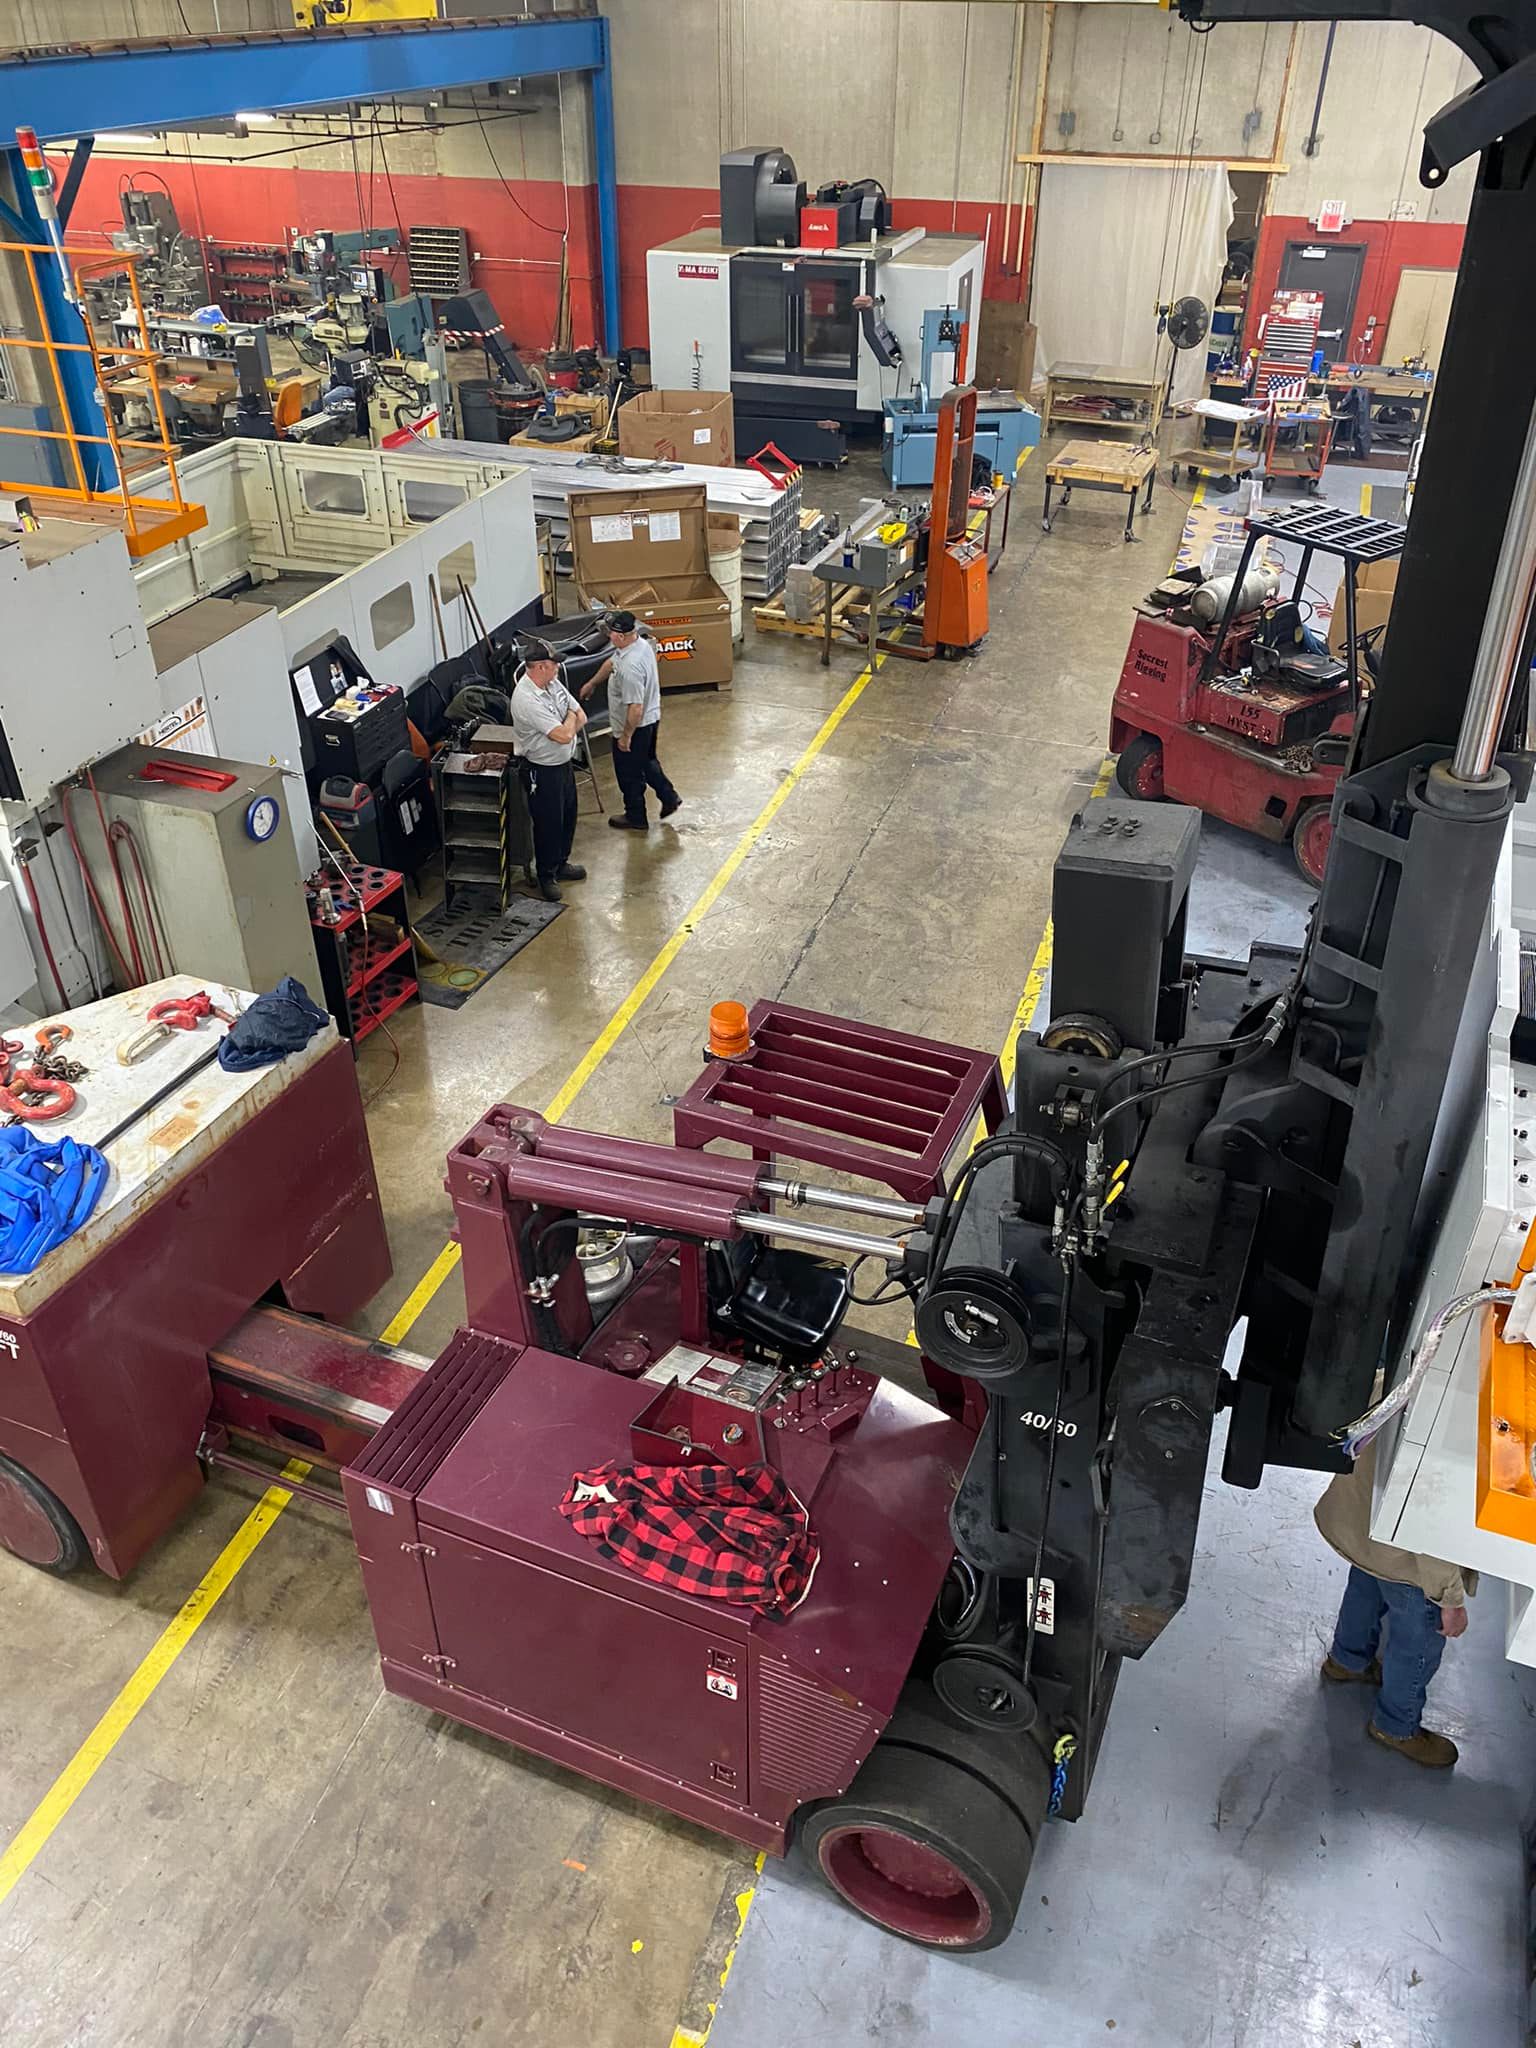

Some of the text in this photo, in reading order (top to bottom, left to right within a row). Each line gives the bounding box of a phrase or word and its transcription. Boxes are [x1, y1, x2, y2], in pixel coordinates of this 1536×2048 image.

[698, 266, 718, 275] SEIKI
[656, 639, 694, 653] AACK
[1227, 715, 1271, 740] HYSTR
